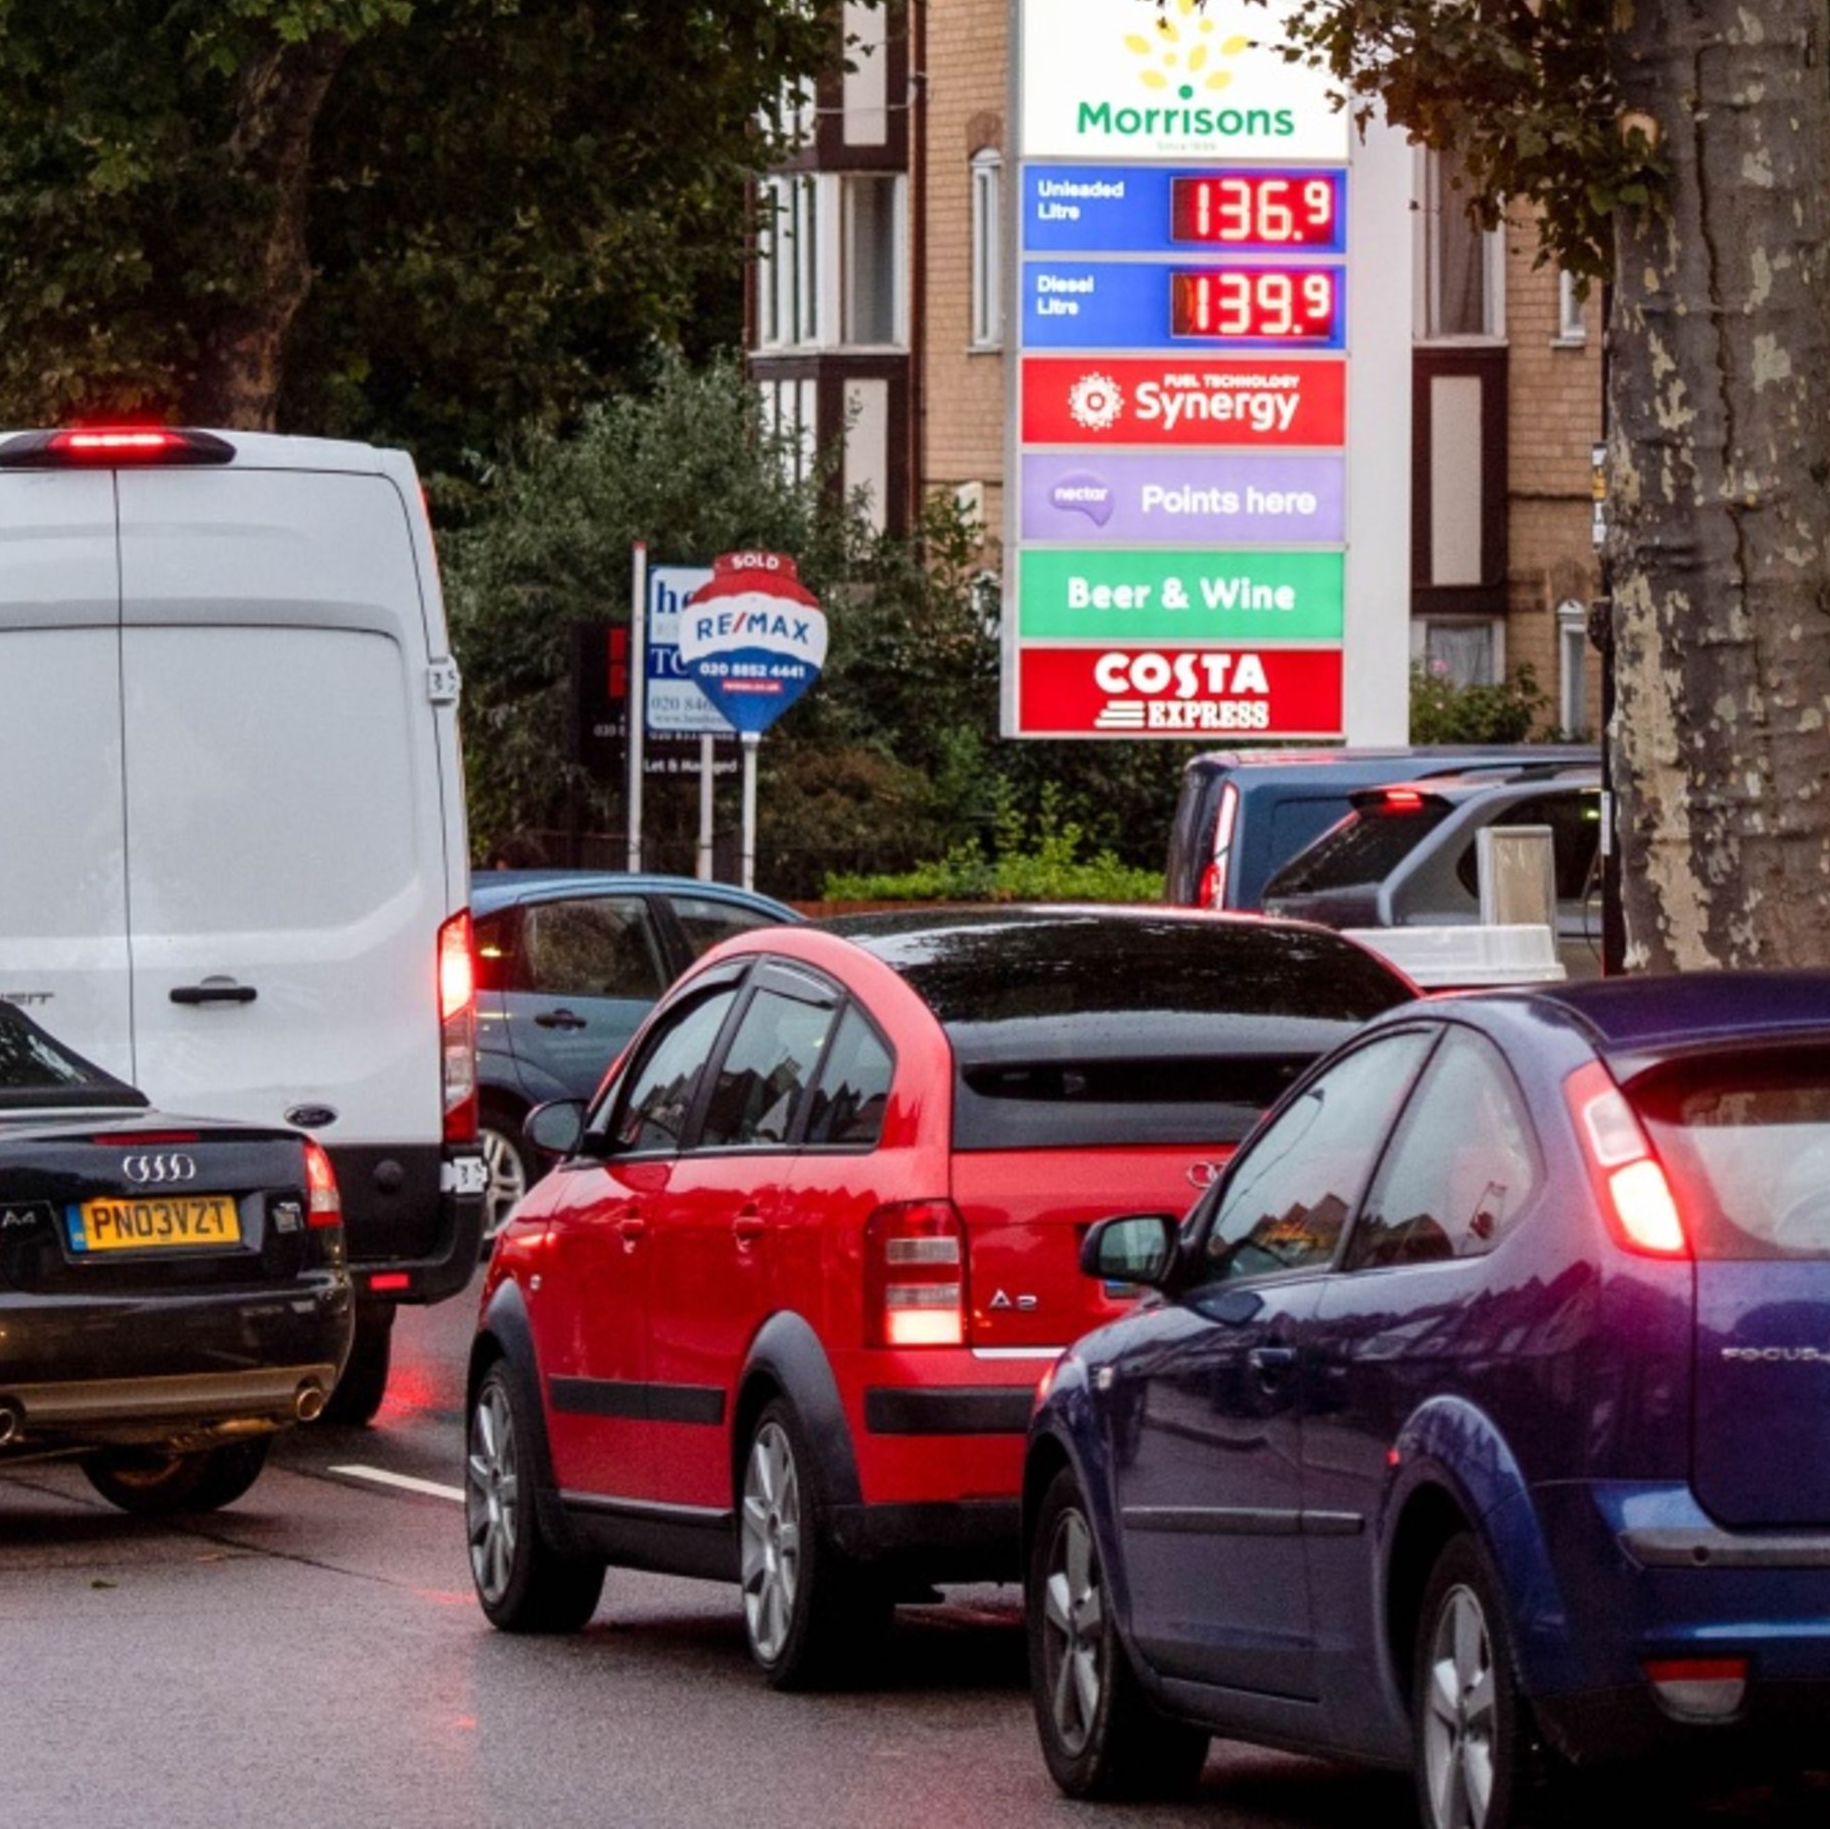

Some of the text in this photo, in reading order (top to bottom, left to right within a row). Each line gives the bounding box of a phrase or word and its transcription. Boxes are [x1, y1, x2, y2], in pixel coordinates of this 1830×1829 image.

[1076, 85, 1295, 136] Morrisons
[1038, 181, 1125, 198] Unleaded
[1038, 203, 1080, 220] Litre
[1037, 275, 1094, 293] Diesel
[1037, 298, 1079, 316] Litre
[1164, 374, 1300, 388] FUEL TECHNOLOGY
[1135, 382, 1301, 432] Synergy
[1054, 486, 1317, 514] nectar Points here
[732, 552, 779, 569] SOLD
[1068, 578, 1296, 610] Beer & Wine
[697, 612, 809, 644] RE/MAX
[700, 662, 728, 676] 020
[1094, 654, 1269, 698] COSTA
[1147, 702, 1269, 729] EXPRESS
[91, 1202, 226, 1239] PN03VZT
[1722, 1348, 1822, 1361] FOCUS
